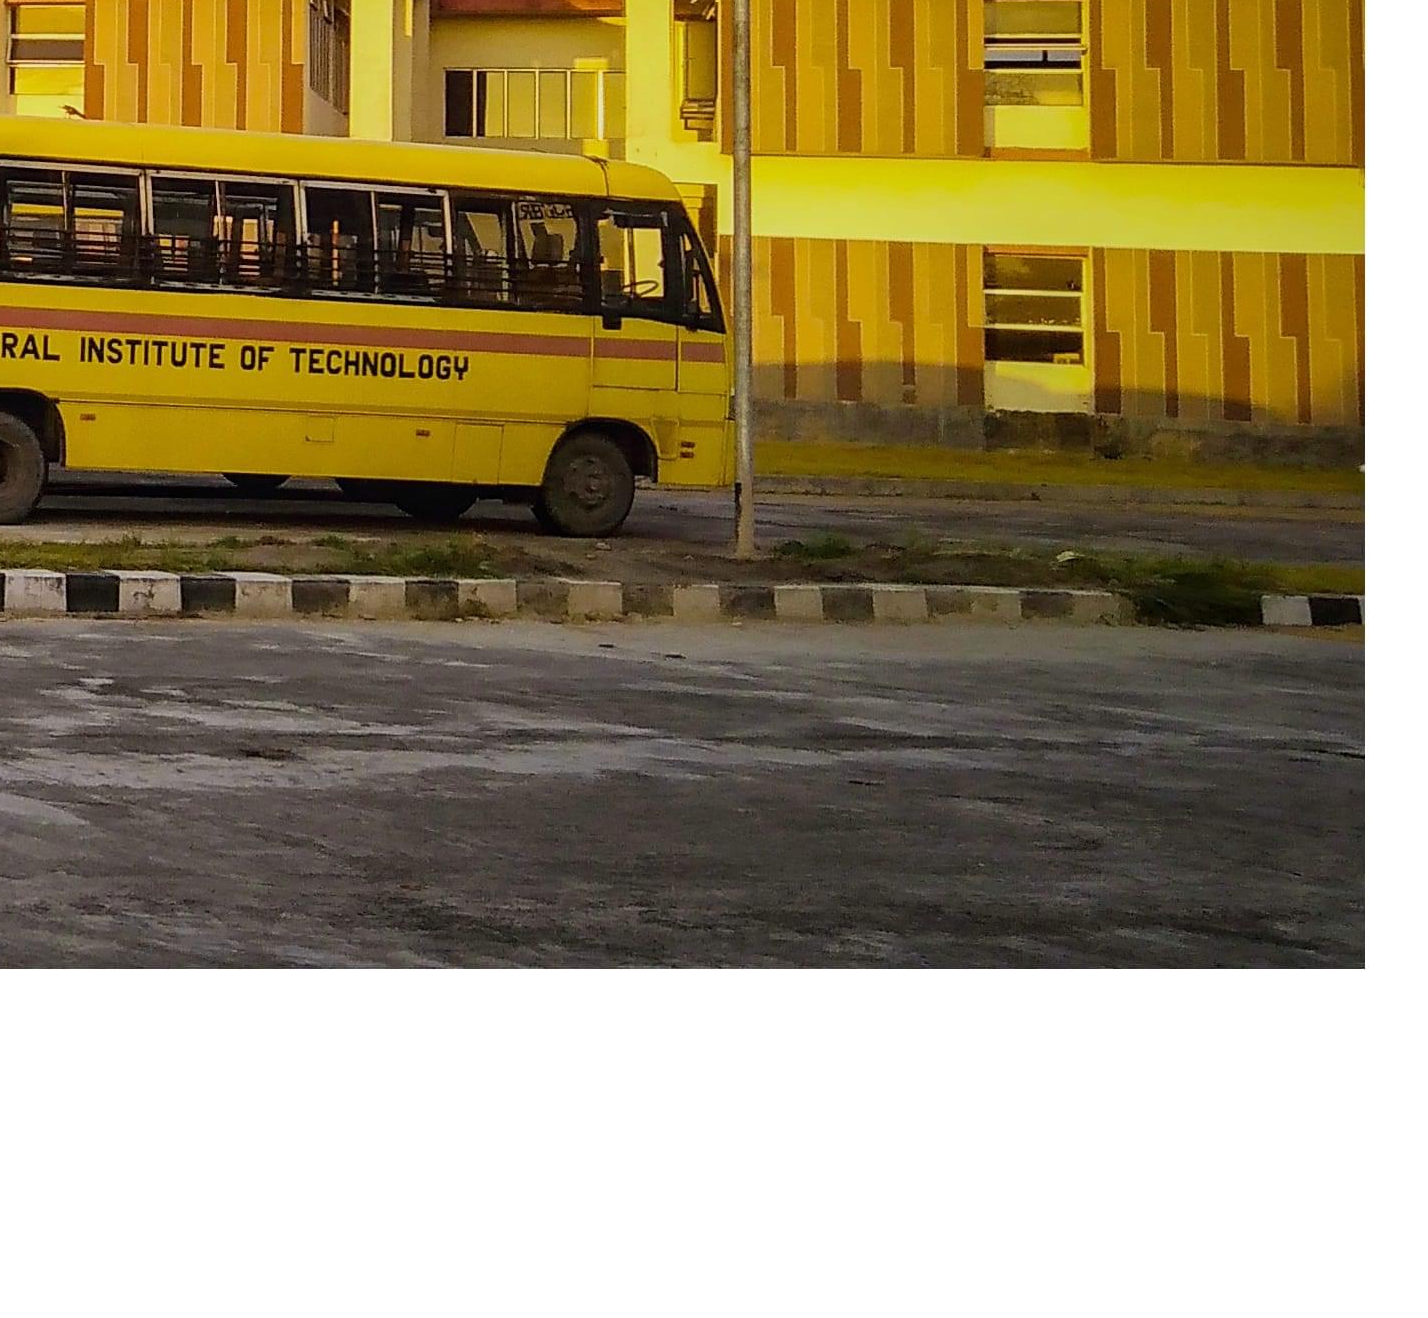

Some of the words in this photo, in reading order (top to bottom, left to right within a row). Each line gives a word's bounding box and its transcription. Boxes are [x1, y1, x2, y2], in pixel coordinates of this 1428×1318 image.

[80, 336, 226, 370] INSTITUTE
[240, 344, 275, 372] OF
[289, 347, 470, 381] TECHNOLOGY
